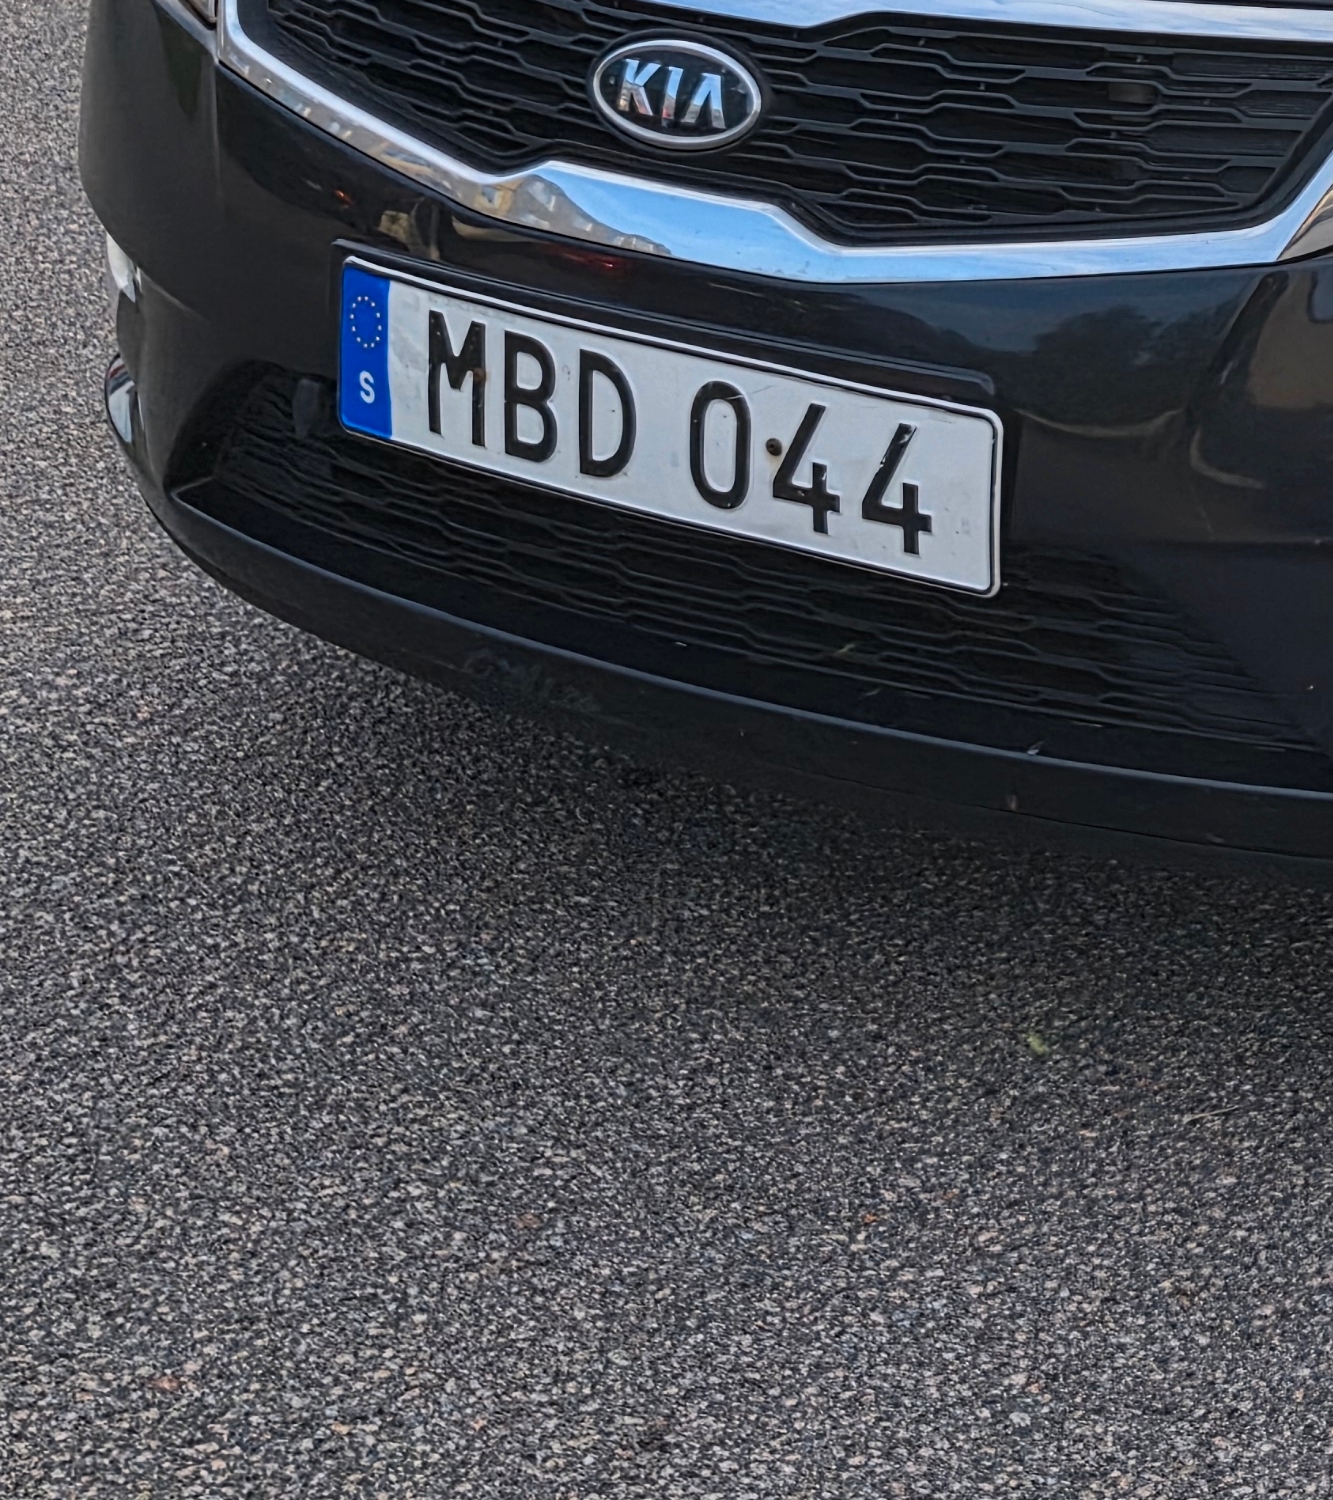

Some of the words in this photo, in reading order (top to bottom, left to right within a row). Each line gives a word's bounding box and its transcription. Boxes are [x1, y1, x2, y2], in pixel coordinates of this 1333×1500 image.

[617, 58, 727, 129] KIA
[359, 370, 375, 404] S
[427, 309, 637, 478] MBD
[689, 380, 933, 555] 044
